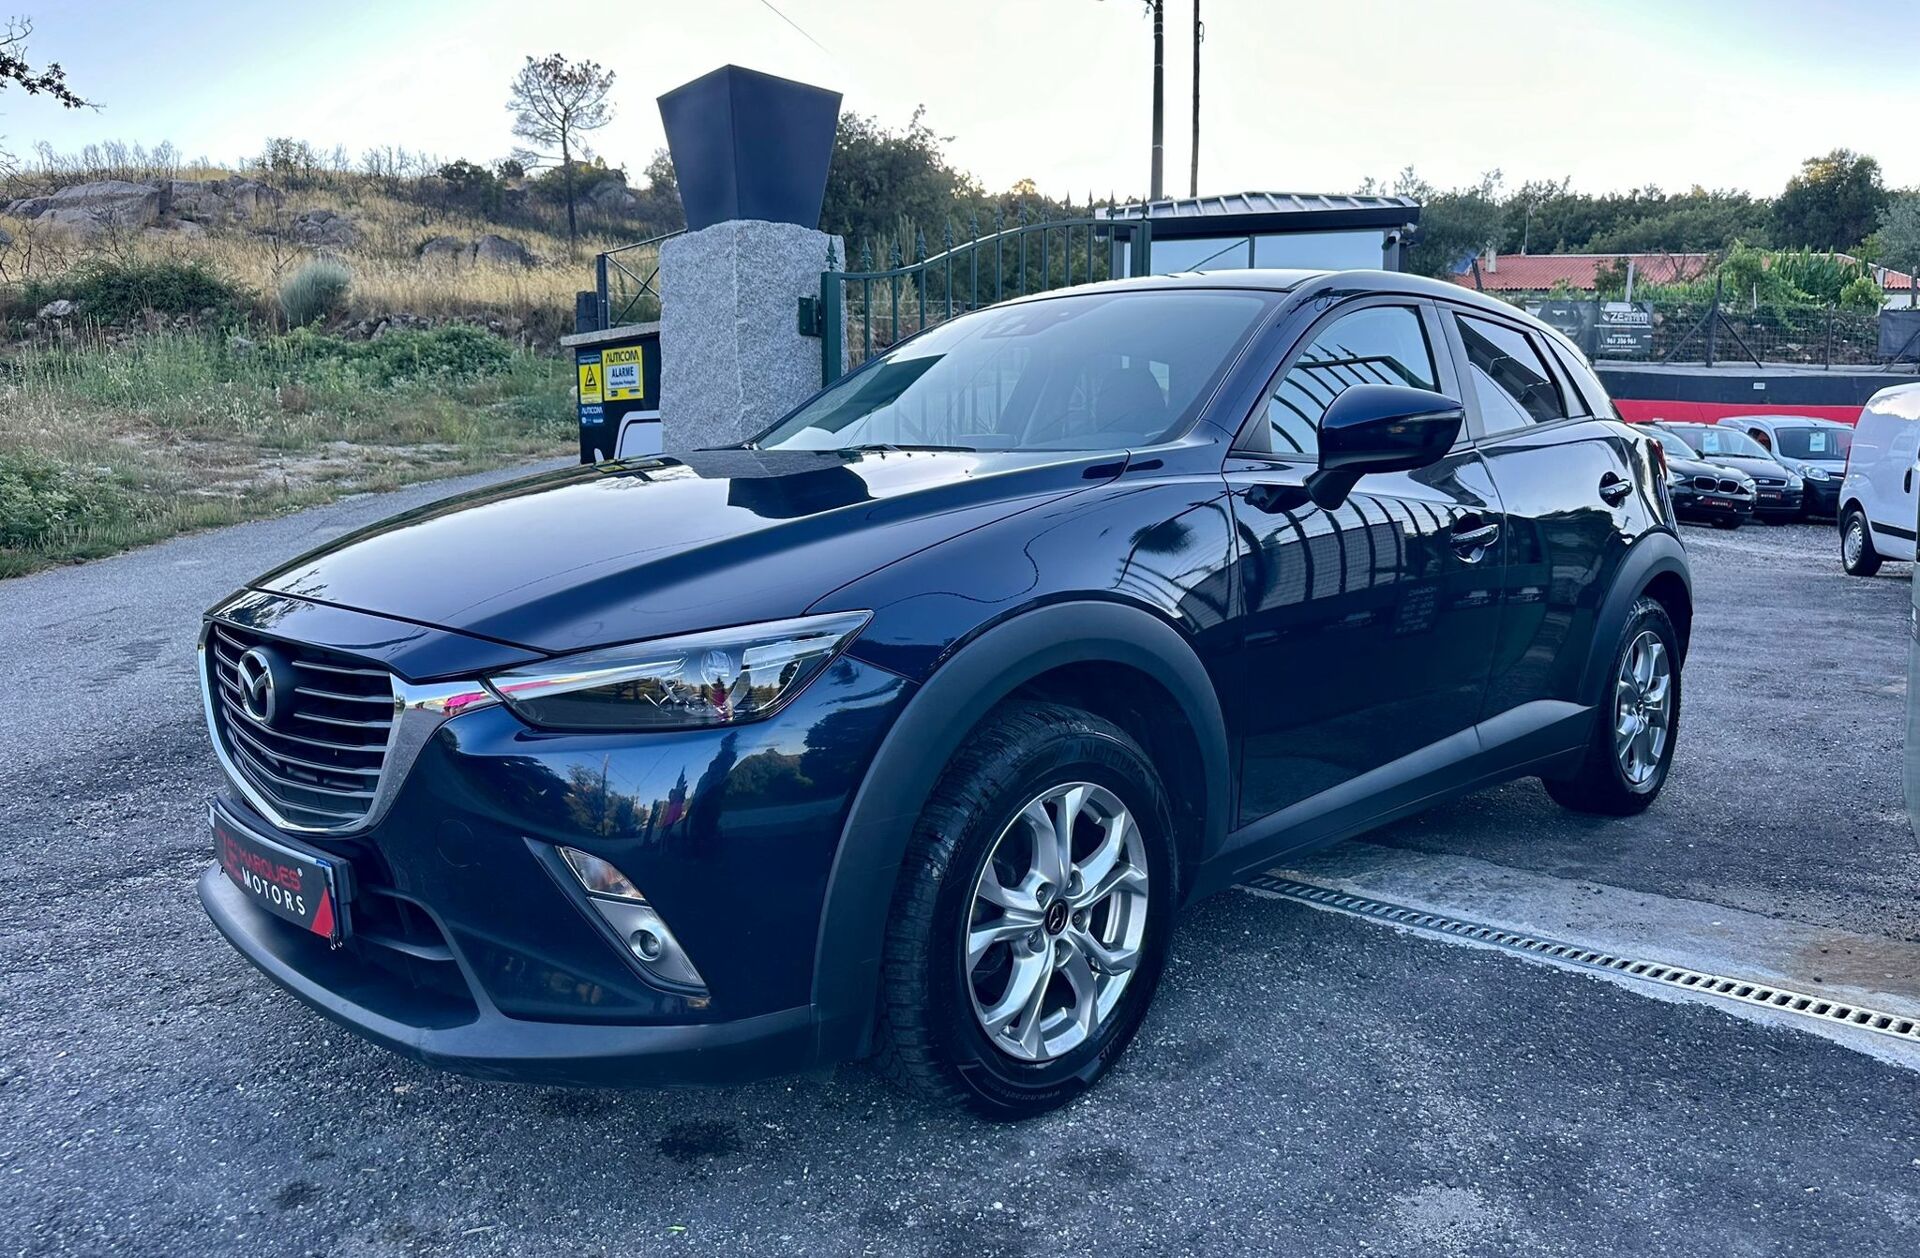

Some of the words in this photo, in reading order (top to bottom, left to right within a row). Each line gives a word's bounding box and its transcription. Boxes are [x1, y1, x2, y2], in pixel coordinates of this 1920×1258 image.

[606, 350, 639, 363] AUTICOM
[612, 366, 634, 378] ALARME
[242, 866, 305, 915] MOTORS
